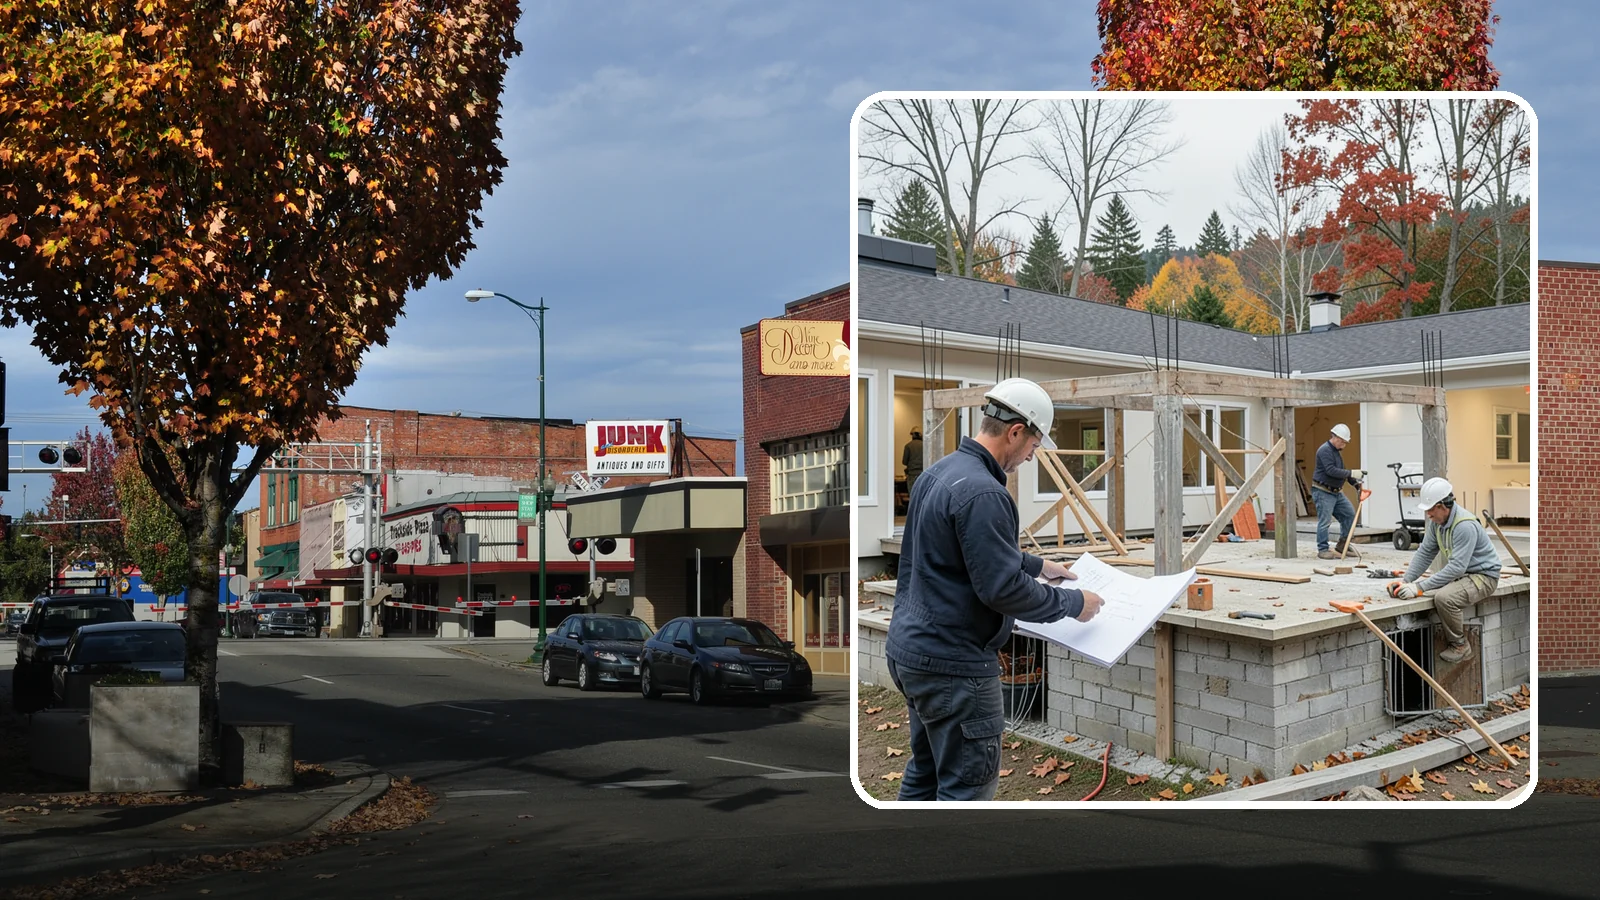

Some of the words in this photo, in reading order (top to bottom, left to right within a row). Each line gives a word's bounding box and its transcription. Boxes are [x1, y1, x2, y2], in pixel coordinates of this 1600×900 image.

[764, 327, 831, 365] Decor
[595, 425, 665, 457] JUNK
[607, 446, 645, 454] DISORDERLY
[596, 461, 628, 470] ANTIQUES
[631, 461, 644, 470] AND
[647, 460, 665, 470] GIFTS
[414, 519, 429, 535] Pizza
